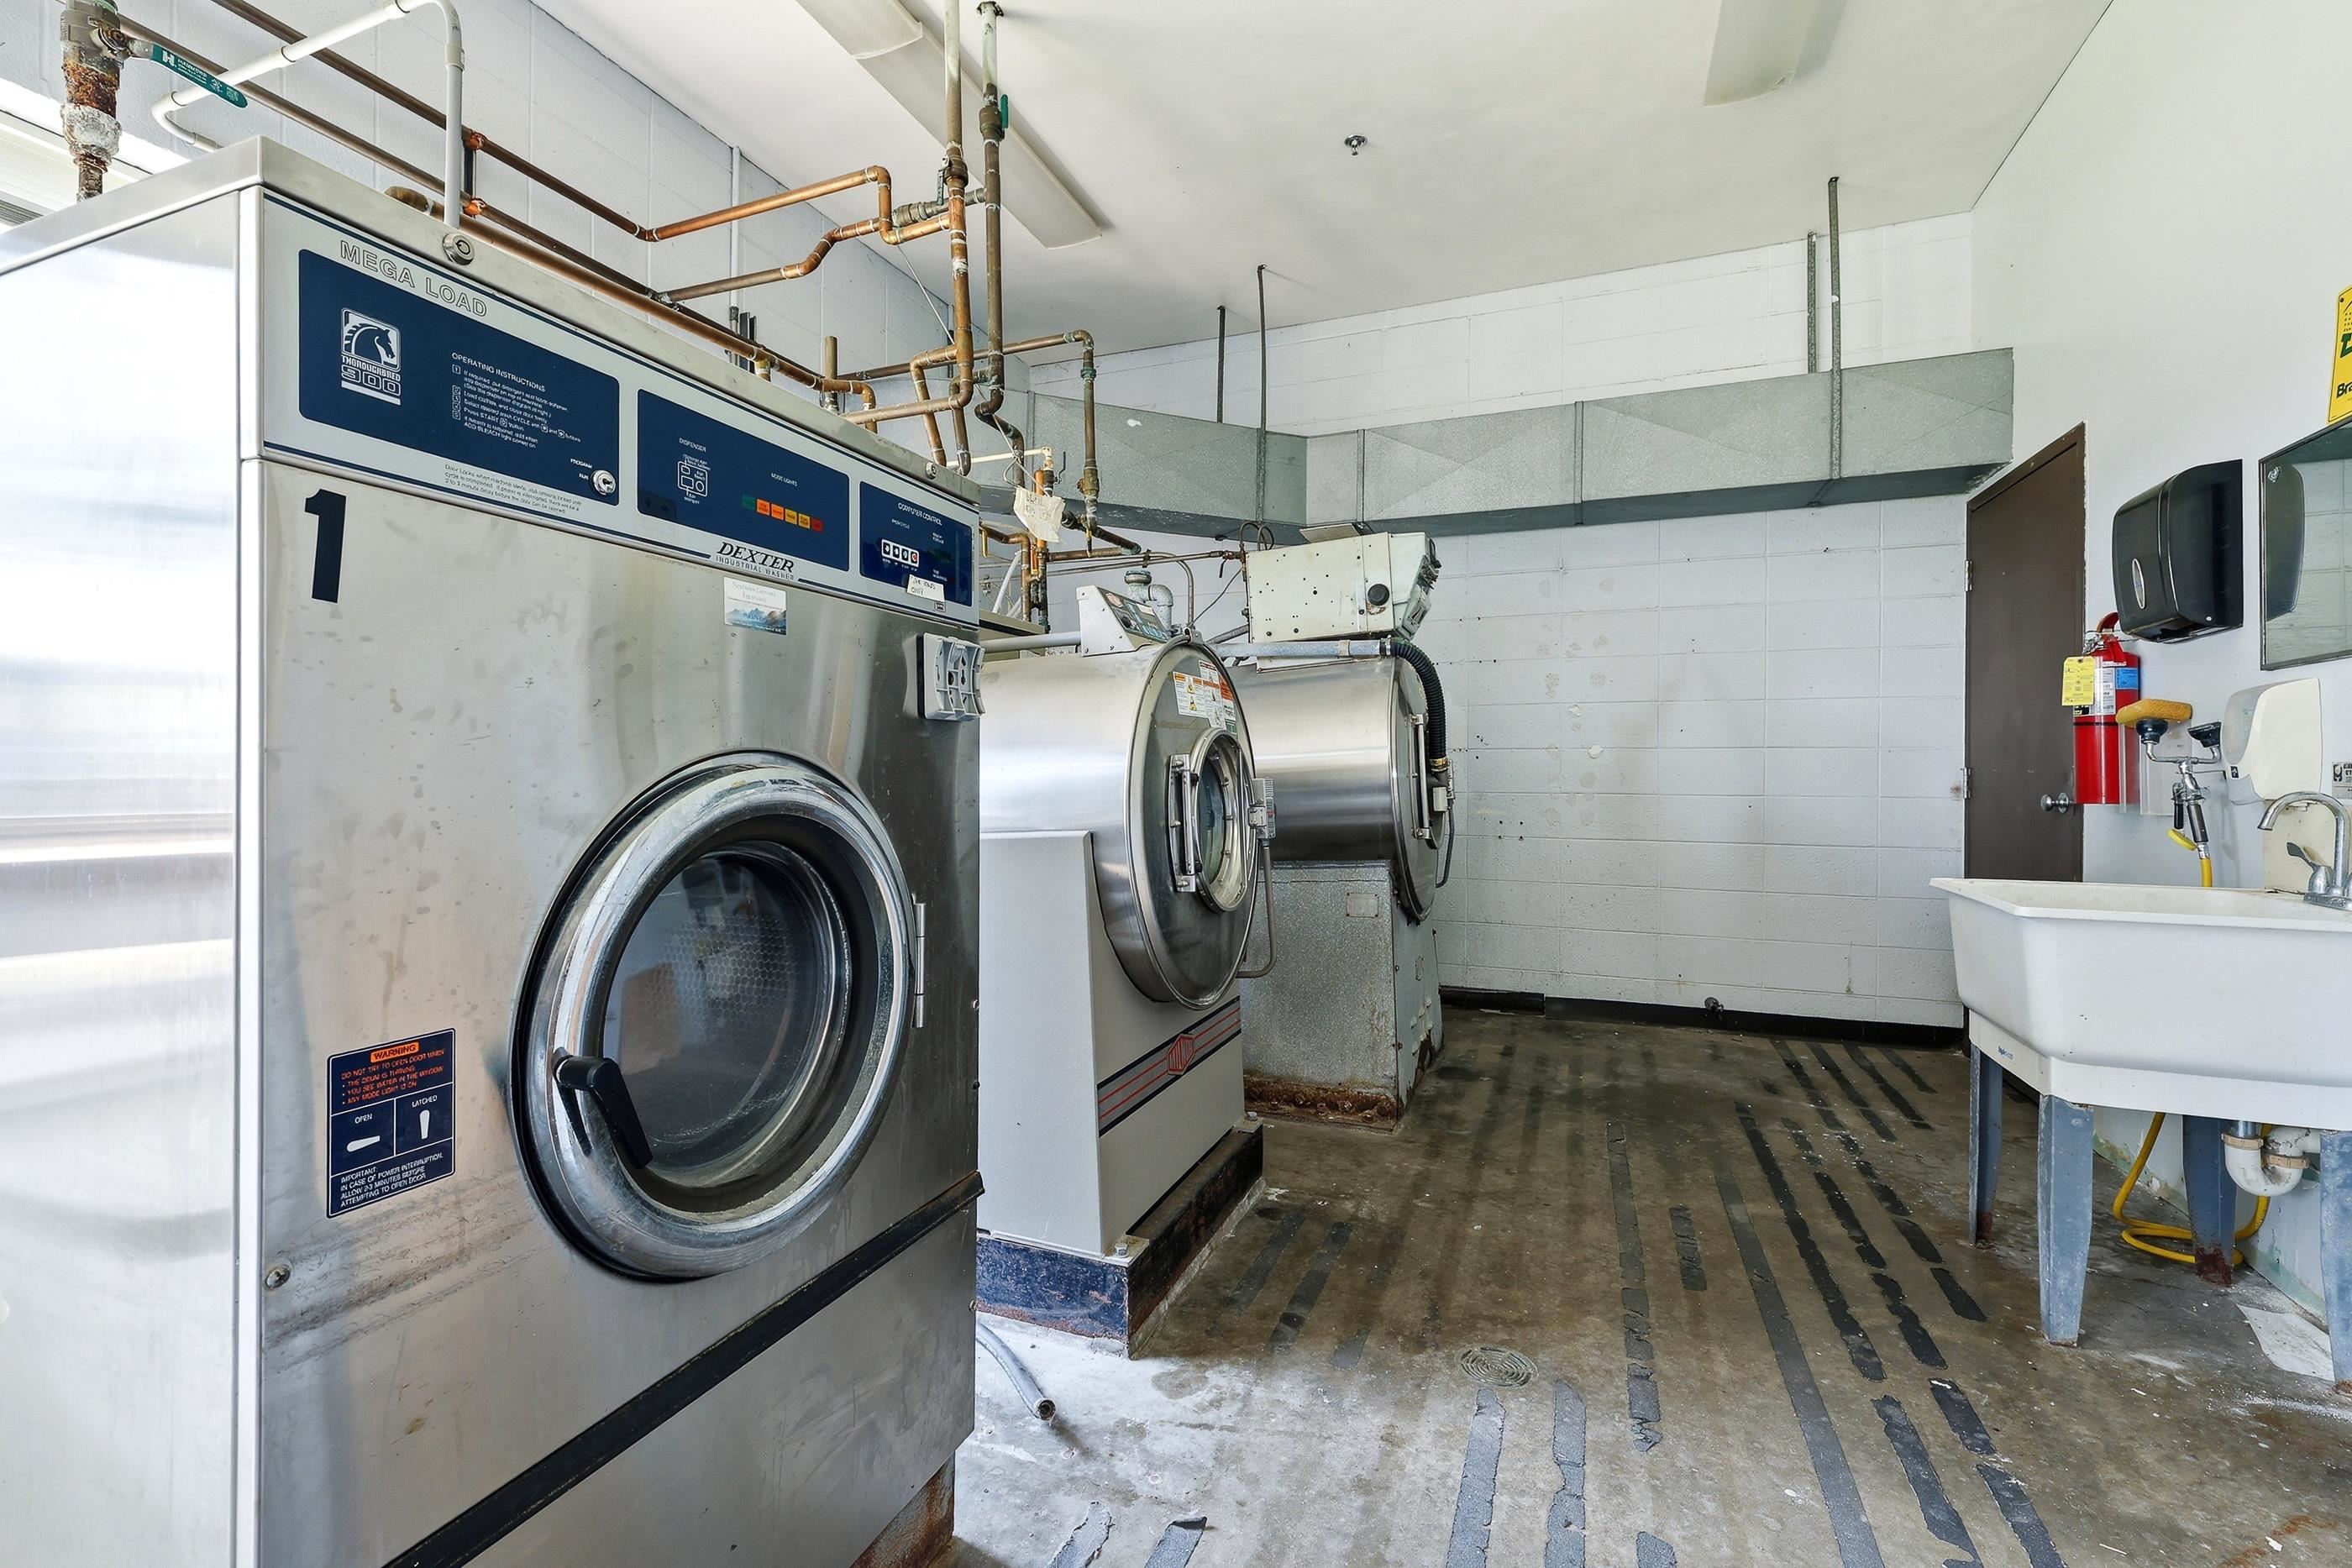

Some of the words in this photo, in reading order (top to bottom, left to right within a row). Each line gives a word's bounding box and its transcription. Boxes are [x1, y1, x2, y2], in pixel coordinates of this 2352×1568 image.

[340, 240, 415, 288] MEGA
[426, 276, 487, 317] LOAD
[341, 354, 401, 381] THOROUGHBRED
[452, 353, 495, 374] OPERATING
[496, 369, 546, 392] INSTRUCTIONS
[305, 488, 347, 603] 1
[717, 542, 794, 573] DEXTER
[716, 555, 762, 574] INDUSTRIAL
[373, 1044, 417, 1060] WARNING
[411, 1094, 438, 1108] LATCHED
[354, 1113, 373, 1125] OPEN
[340, 1188, 363, 1200] ALLOW
[374, 1174, 402, 1189] MINUTES
[349, 1178, 366, 1189] CASE
[367, 1173, 376, 1183] OF
[378, 1167, 401, 1180] POWER
[340, 1191, 381, 1208] ATTEMPTING
[381, 1185, 390, 1193] TO
[391, 1181, 408, 1191] OPEN
